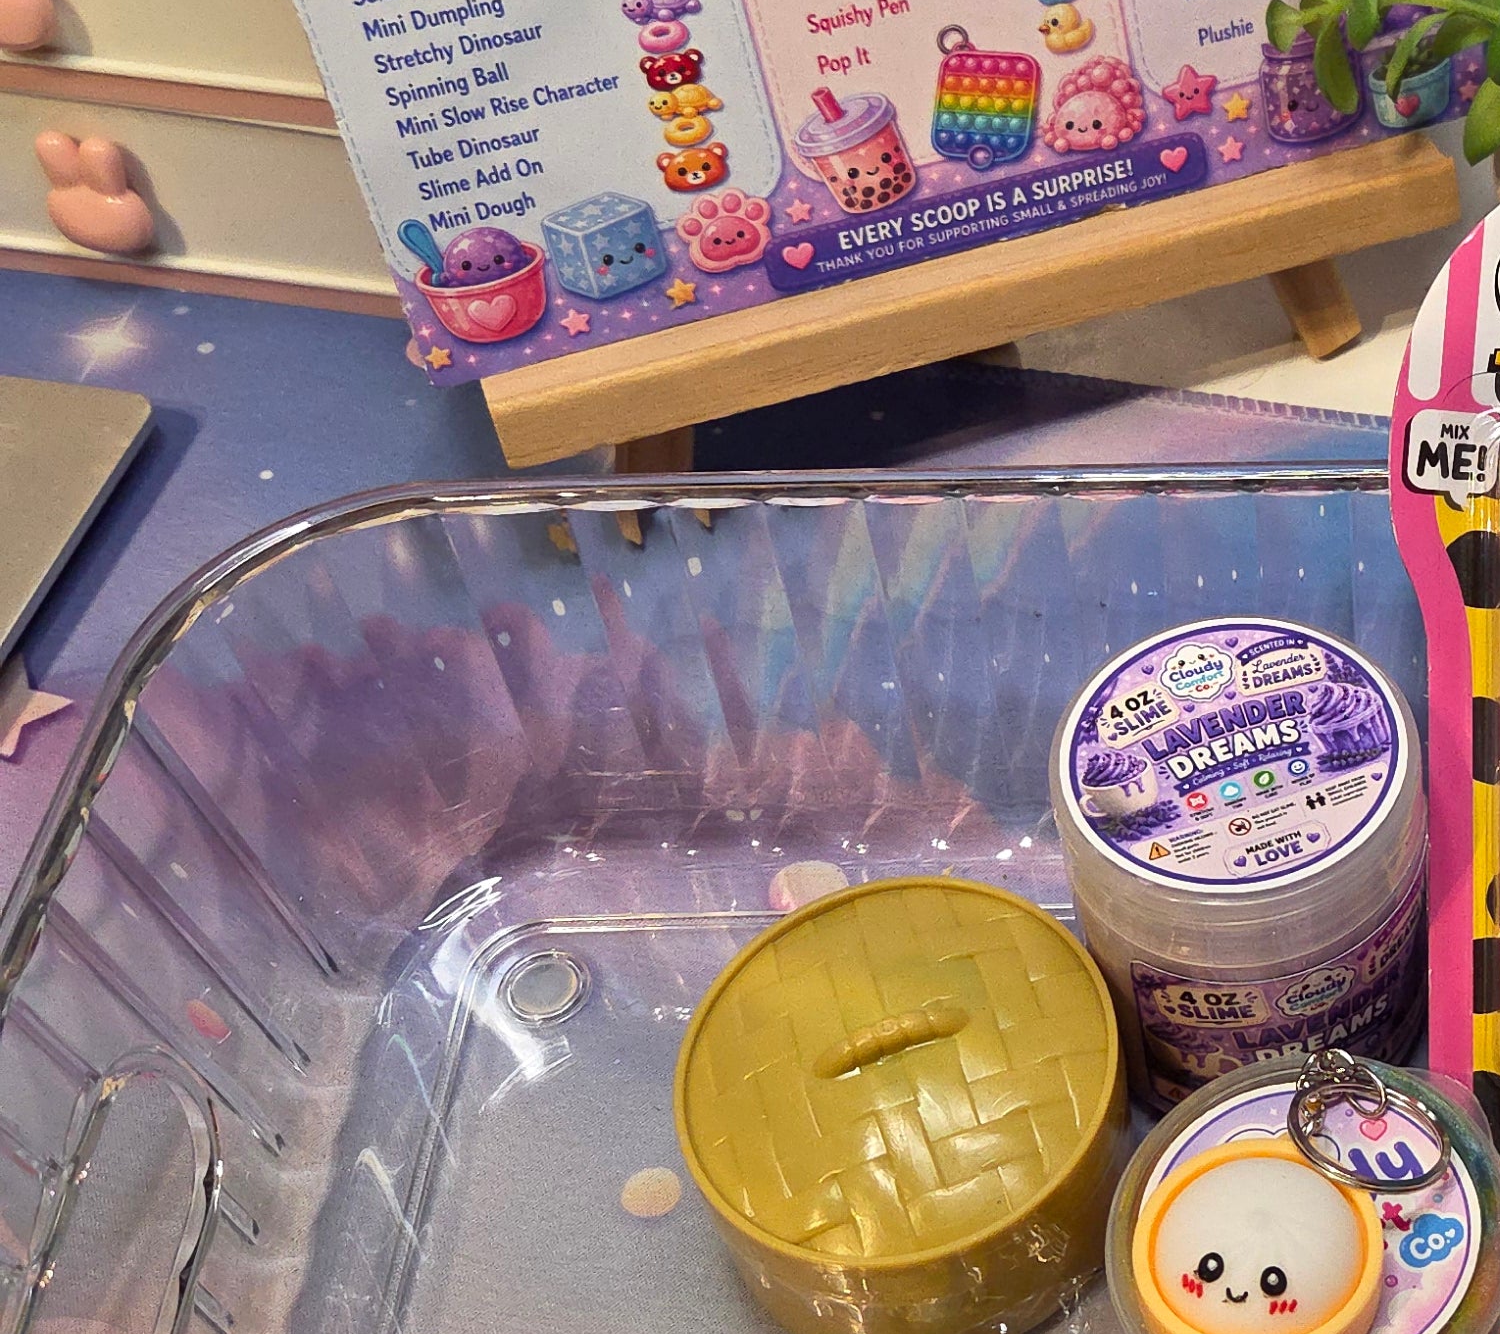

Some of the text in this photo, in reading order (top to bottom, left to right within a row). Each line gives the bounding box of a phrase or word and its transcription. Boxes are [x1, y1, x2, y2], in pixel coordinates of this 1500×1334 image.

[362, 14, 408, 42] Mini
[807, 6, 873, 36] Squishy
[1198, 18, 1254, 46] Plushie
[374, 21, 543, 75] Stretchy Dinosaur
[816, 47, 872, 77] Pop It
[385, 62, 510, 107] Spinning Ball
[396, 73, 620, 139] Mini Slow Rise Character
[407, 125, 540, 171] Tube Dinosaur
[418, 158, 544, 201] Slime Add On
[429, 191, 536, 231] Mini Dough
[838, 158, 1134, 251] EVERY SCOOP IS A SURPRISE!
[818, 173, 1168, 274] THANK YOU FOR SUPPORTING SMALL & SPREADING JOY!
[1441, 424, 1469, 440] MIX
[1417, 440, 1487, 482] ME!
[1169, 658, 1224, 682] Cloudy
[1252, 653, 1306, 674] Lavender
[1253, 663, 1313, 688] DREAMS
[1110, 691, 1153, 719] 4 OZ
[1114, 700, 1172, 736] SLIME
[1141, 691, 1306, 761] LAVENDER
[1166, 719, 1301, 779] DREAMS
[1246, 831, 1301, 855] MADE WITH
[1254, 841, 1303, 866] LOVE
